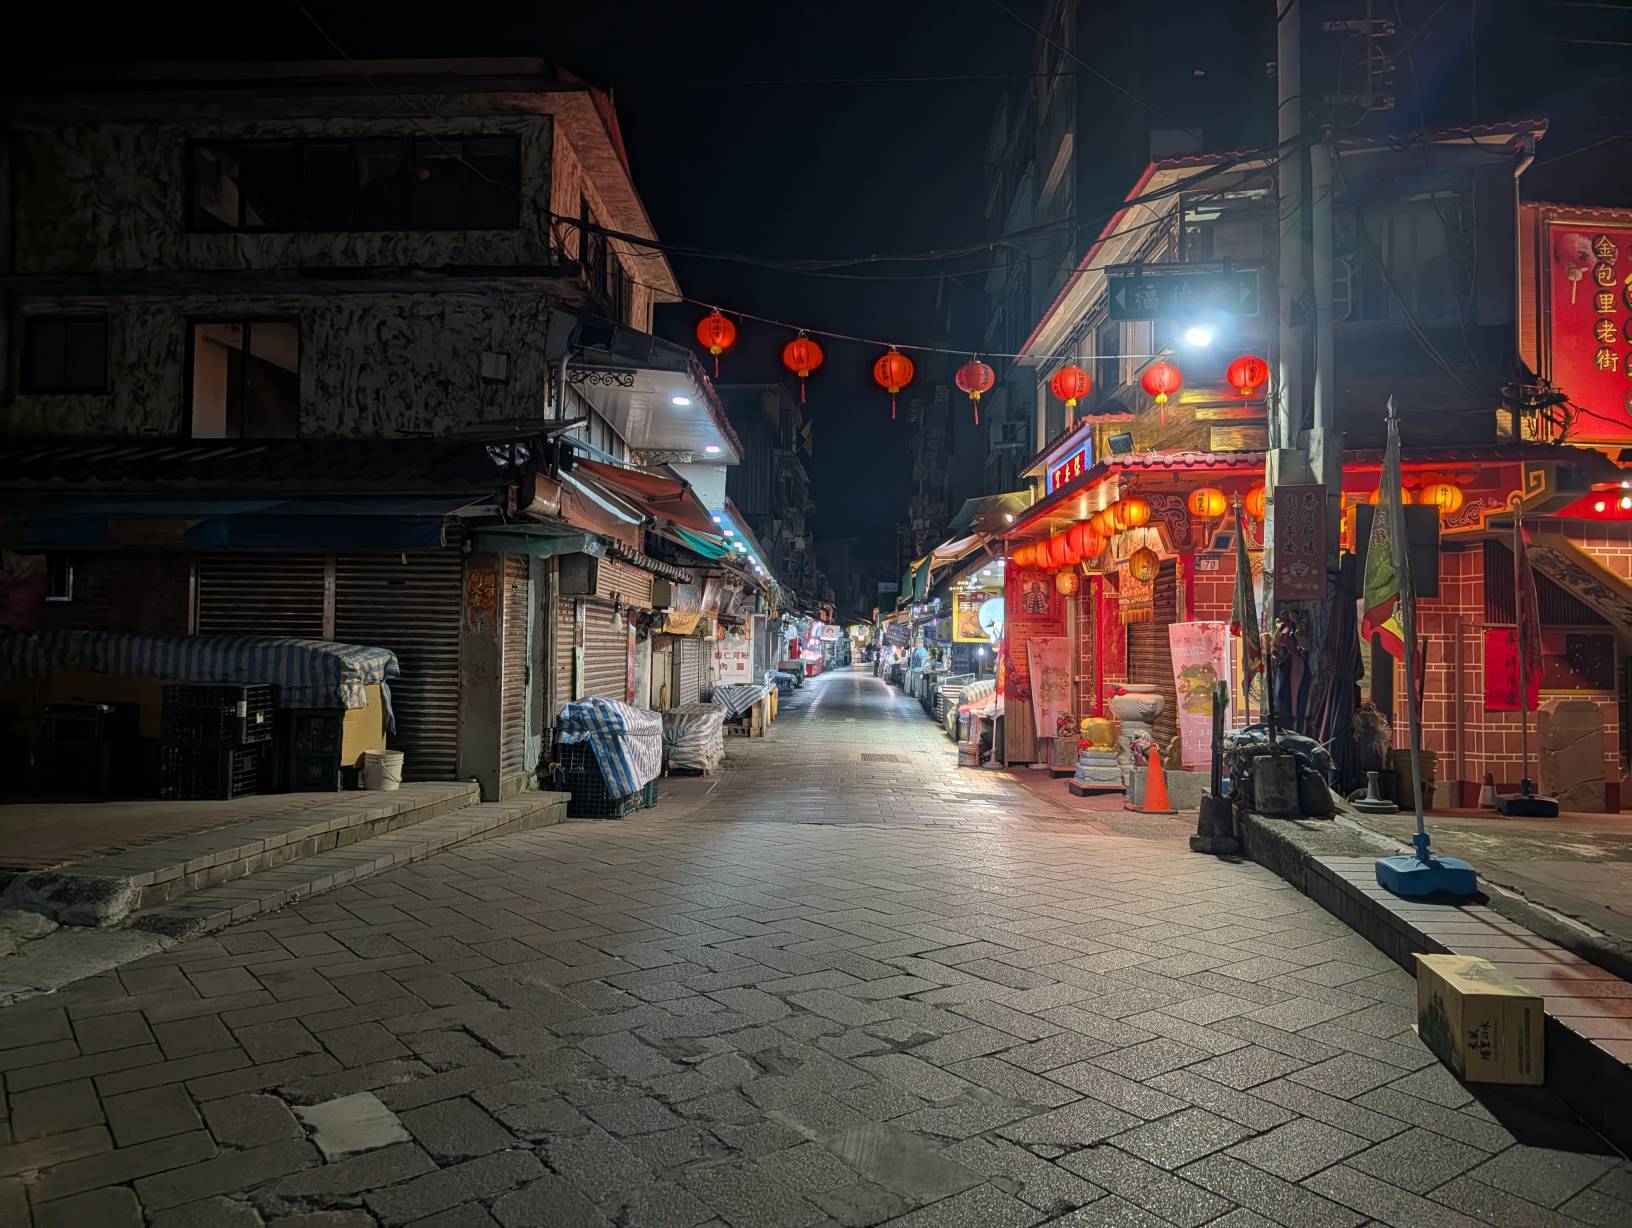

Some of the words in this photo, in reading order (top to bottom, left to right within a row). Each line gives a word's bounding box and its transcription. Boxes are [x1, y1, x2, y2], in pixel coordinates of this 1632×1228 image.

[1595, 234, 1619, 373] 金包里老街
[1204, 560, 1216, 570] 70
